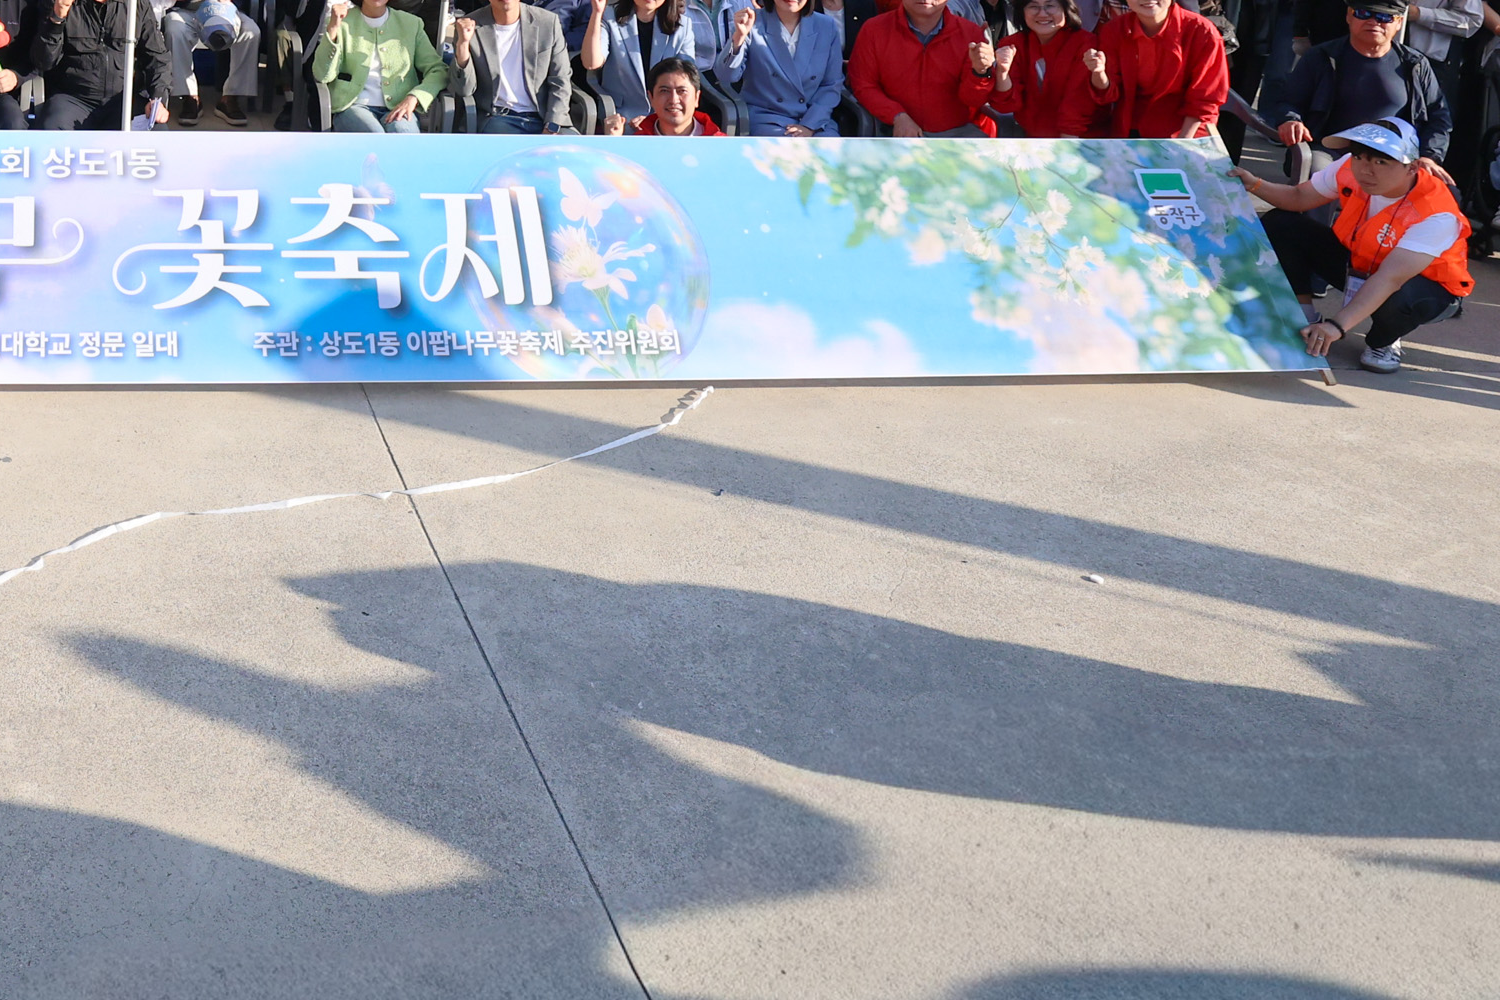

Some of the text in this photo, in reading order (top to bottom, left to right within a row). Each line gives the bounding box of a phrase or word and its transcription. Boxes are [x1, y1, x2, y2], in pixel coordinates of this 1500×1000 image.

[43, 146, 160, 179] 상도1동
[1153, 204, 1201, 225] 동작구
[112, 183, 555, 310] 꽃축제
[78, 331, 126, 358] 정문
[132, 331, 179, 358] 일대
[252, 331, 300, 358] 주관
[318, 330, 400, 358] 상도1동
[406, 329, 565, 357] 이팝나무꽃축제
[569, 329, 682, 356] 추진위원회
